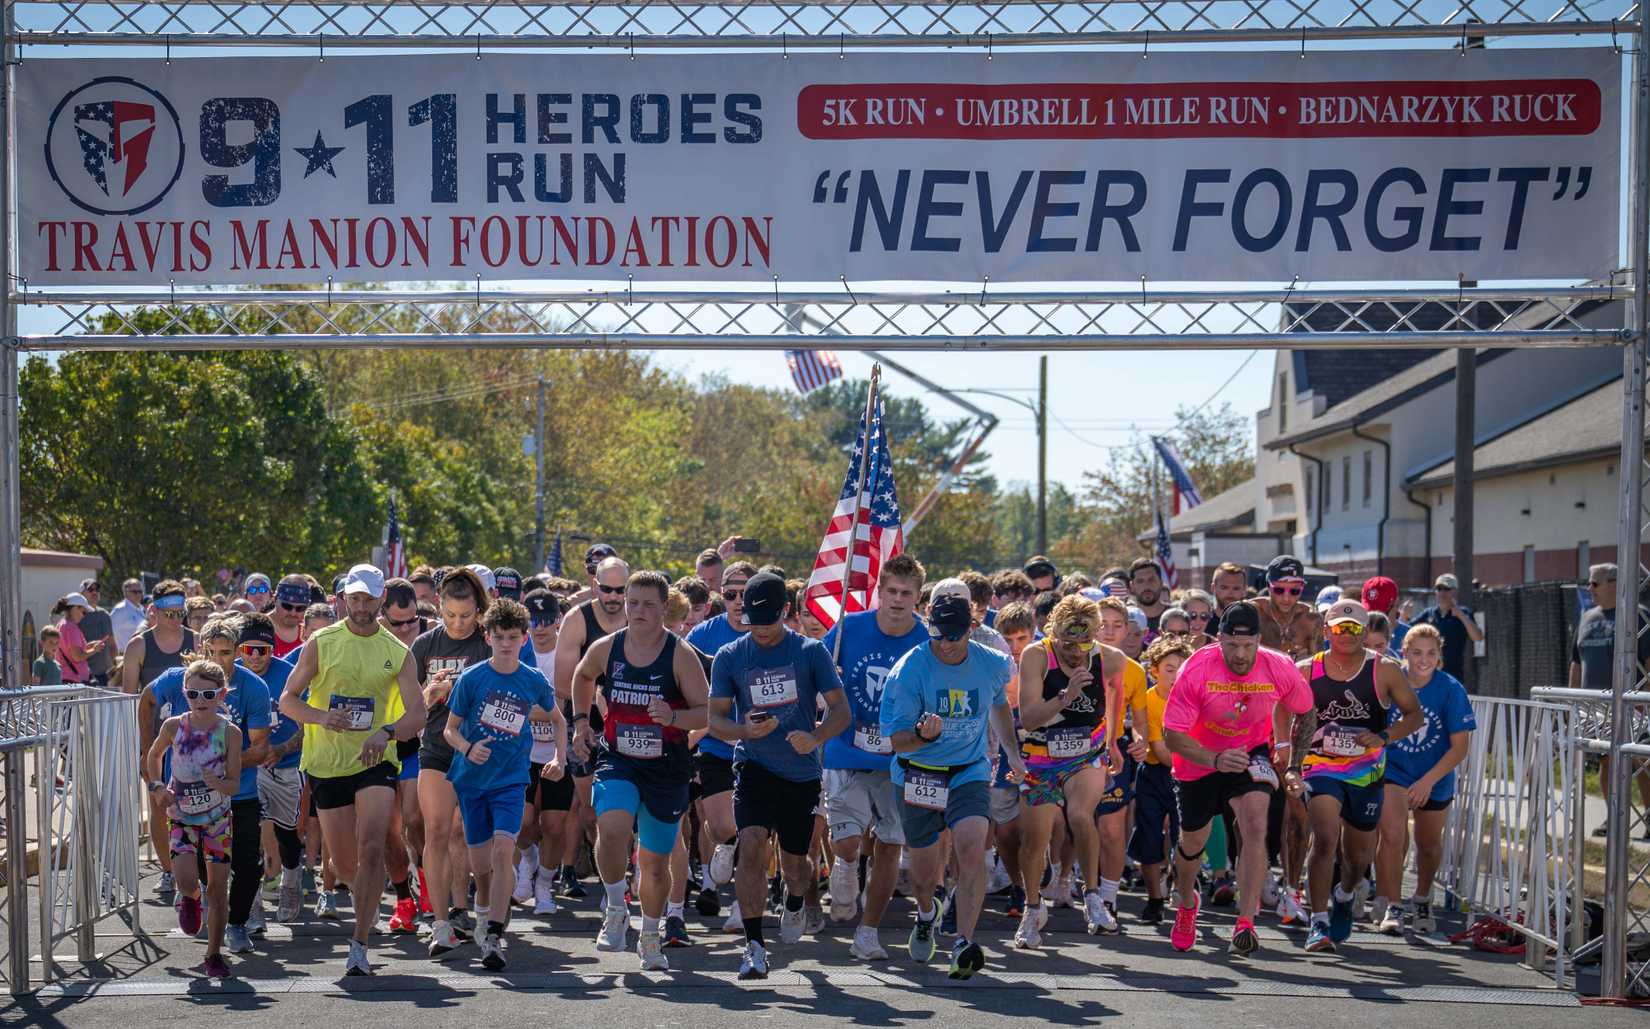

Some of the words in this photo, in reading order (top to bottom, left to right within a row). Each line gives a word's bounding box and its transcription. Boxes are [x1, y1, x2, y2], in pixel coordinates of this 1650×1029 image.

[485, 93, 763, 145] HEROES
[822, 98, 857, 126] 5K
[865, 97, 926, 126] RUN
[955, 97, 1098, 126] UMBRELL
[1103, 98, 1117, 125] 1
[1124, 97, 1202, 125] MILE
[1208, 96, 1271, 125] RUN
[1298, 95, 1484, 126] BEDNARZYK
[1491, 93, 1578, 123] RUCK
[198, 97, 281, 207] 9
[343, 93, 459, 205] 11
[486, 153, 627, 203] RUN
[812, 169, 1148, 253] “NEVER
[1172, 167, 1593, 253] FORGET”
[38, 219, 212, 272] TRAVIS
[229, 216, 432, 270] MANION
[448, 215, 774, 269] FOUNDATION
[761, 683, 784, 696] 613
[494, 708, 516, 723] 800
[628, 738, 651, 750] 939
[1055, 740, 1084, 751] 1359
[189, 794, 211, 806] 120
[915, 785, 937, 798] 612
